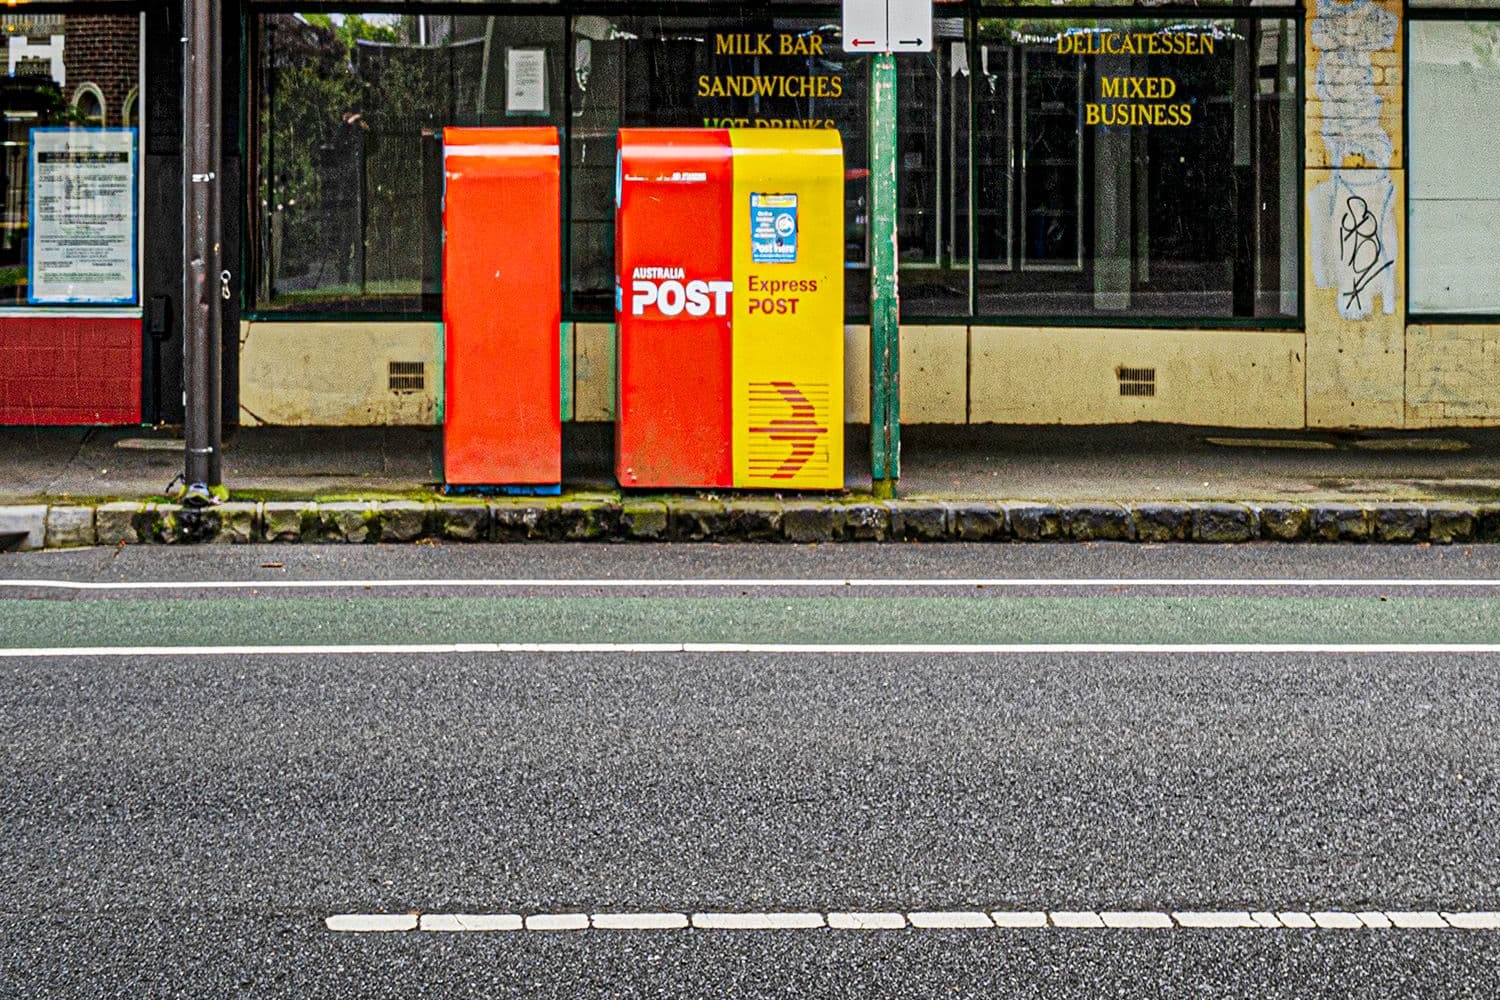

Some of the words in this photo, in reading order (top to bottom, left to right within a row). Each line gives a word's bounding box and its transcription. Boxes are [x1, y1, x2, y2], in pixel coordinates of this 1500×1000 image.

[716, 33, 772, 55] MILK
[780, 33, 824, 55] BAR
[1057, 33, 1214, 55] DELICATESSEN
[698, 75, 842, 97] SANDWICHES
[1101, 77, 1176, 98] MIXED
[1086, 104, 1192, 126] BUSINESS
[633, 267, 685, 279] AUSTRALIA
[748, 275, 818, 293] Express
[632, 280, 733, 316] POST
[748, 298, 799, 314] POST
